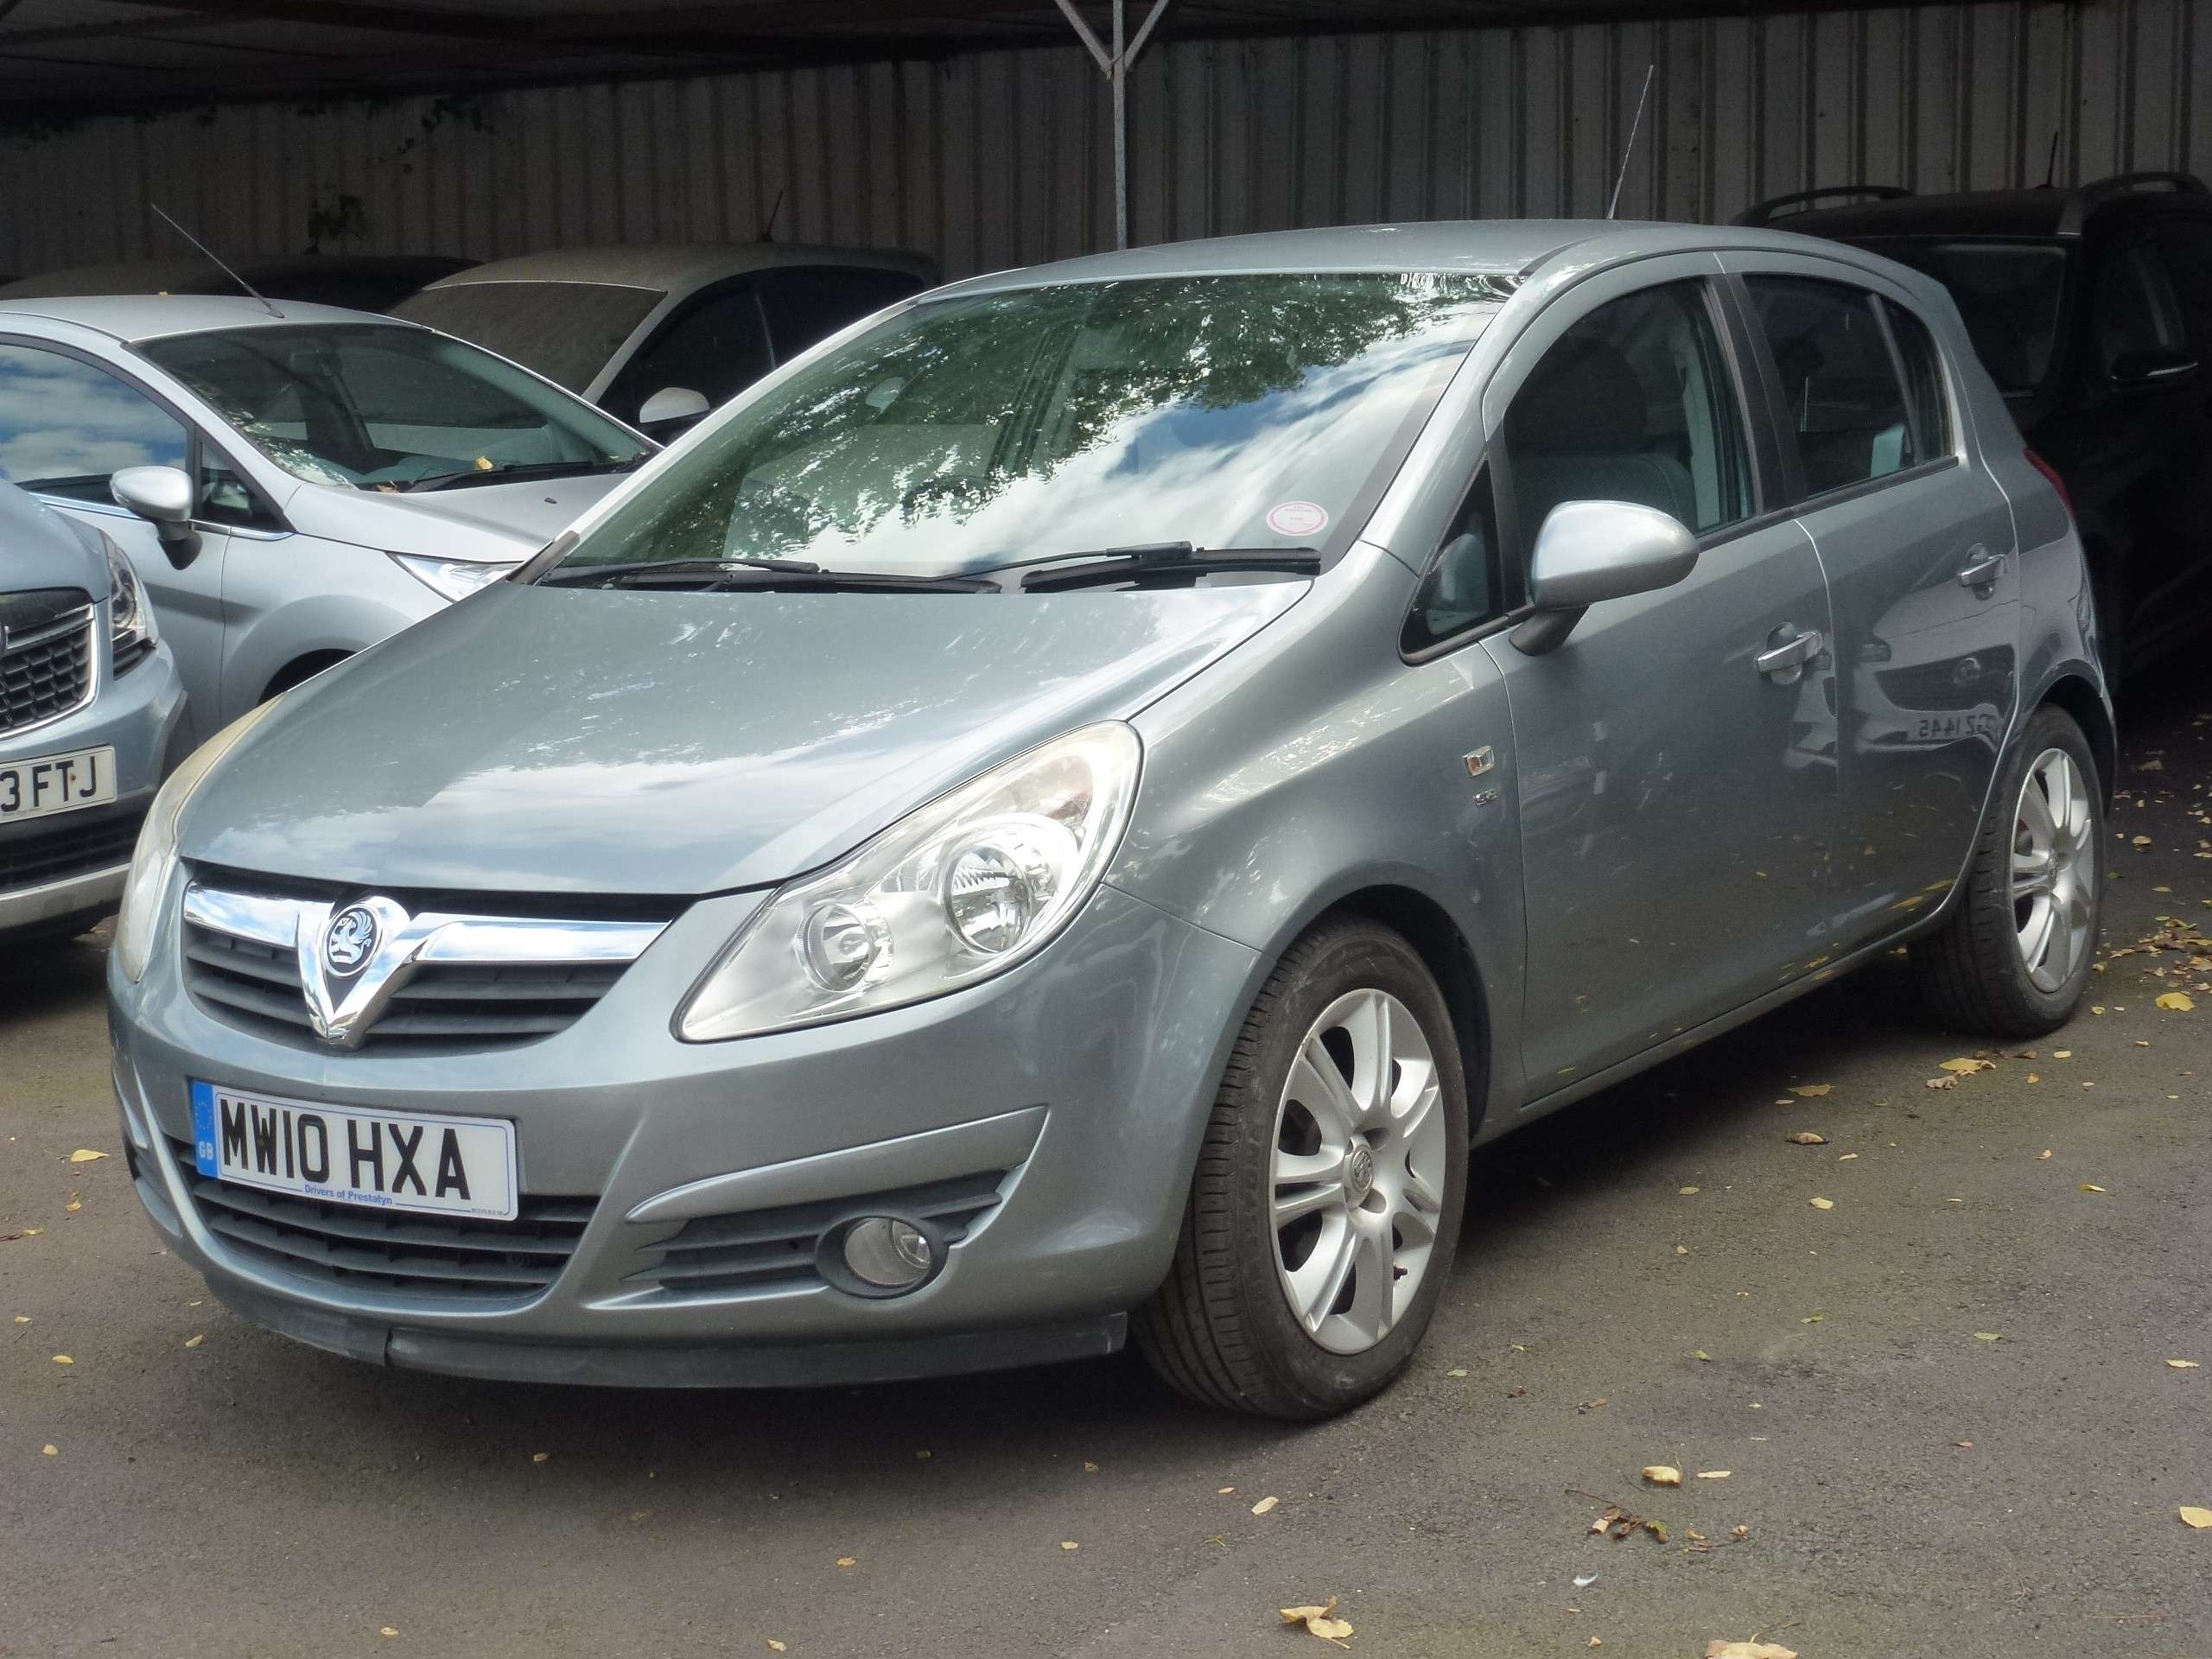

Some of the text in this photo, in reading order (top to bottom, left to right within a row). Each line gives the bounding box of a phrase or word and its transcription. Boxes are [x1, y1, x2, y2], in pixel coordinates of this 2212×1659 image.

[0, 755, 97, 812] 3 FTJ
[198, 1141, 214, 1161] GB
[220, 1099, 471, 1200] MW10 HXA
[304, 1184, 393, 1206] Drivers of Prestatyn
